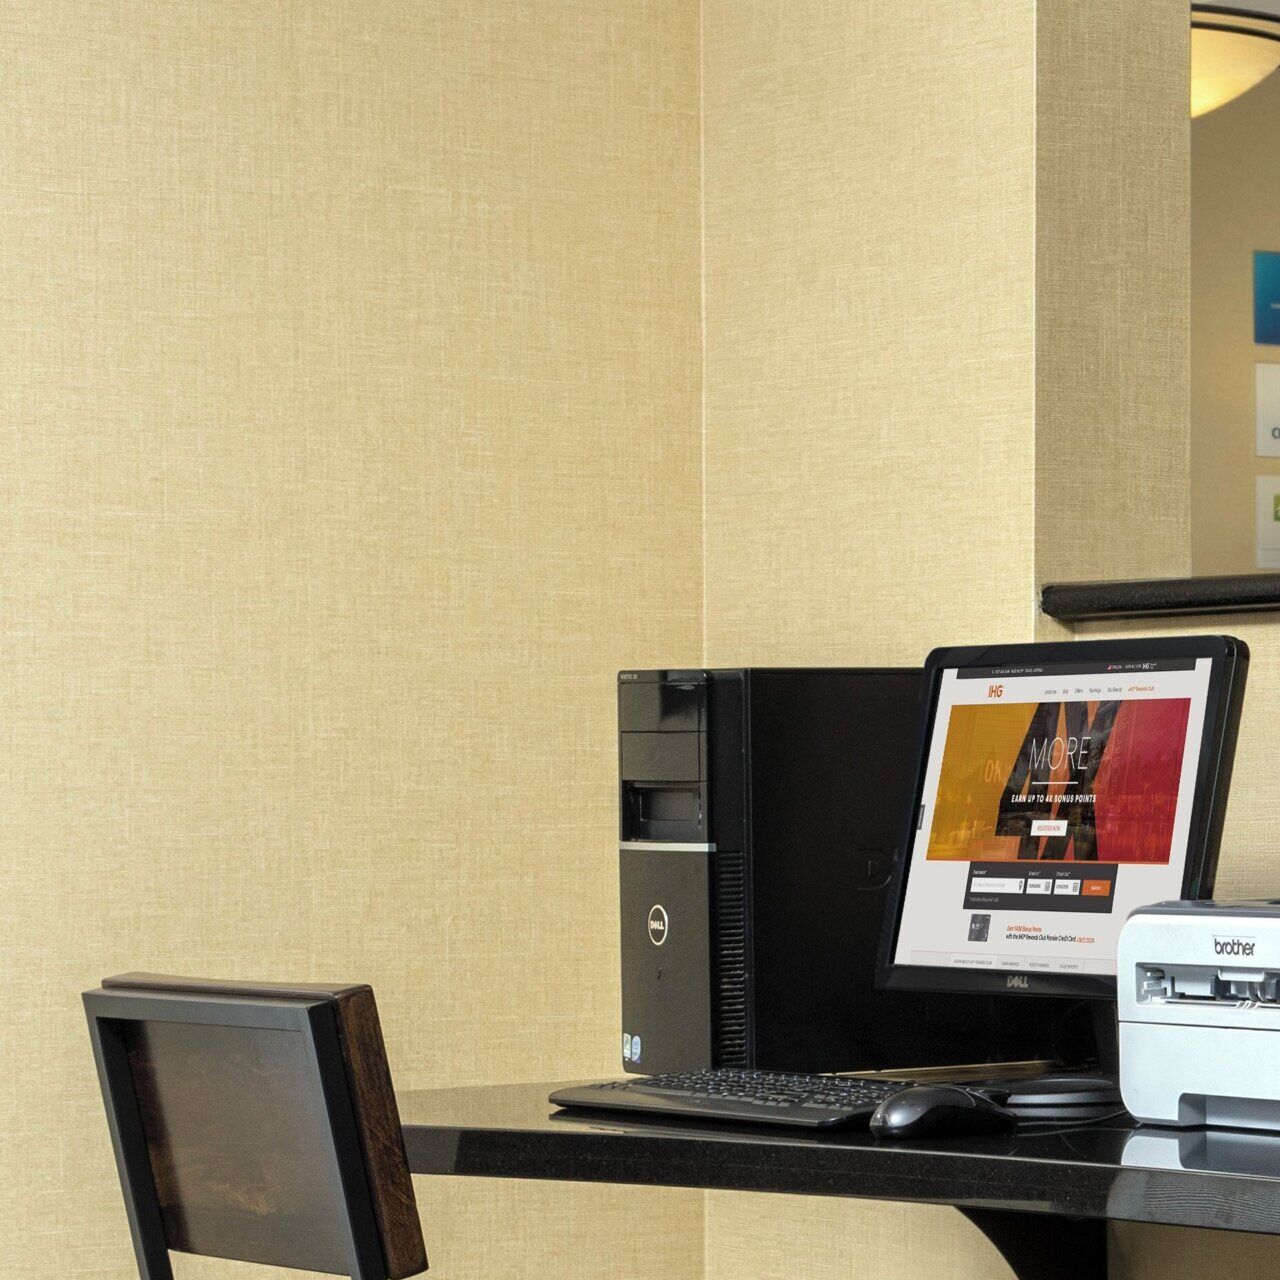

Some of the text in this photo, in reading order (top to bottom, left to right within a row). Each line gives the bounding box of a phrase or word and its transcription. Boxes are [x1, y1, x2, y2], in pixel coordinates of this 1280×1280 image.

[988, 685, 1003, 698] IHG
[1028, 737, 1092, 770] MORE
[1011, 794, 1097, 803] EARN UP TO 4X BONUS POINTS
[1214, 938, 1256, 957] brother
